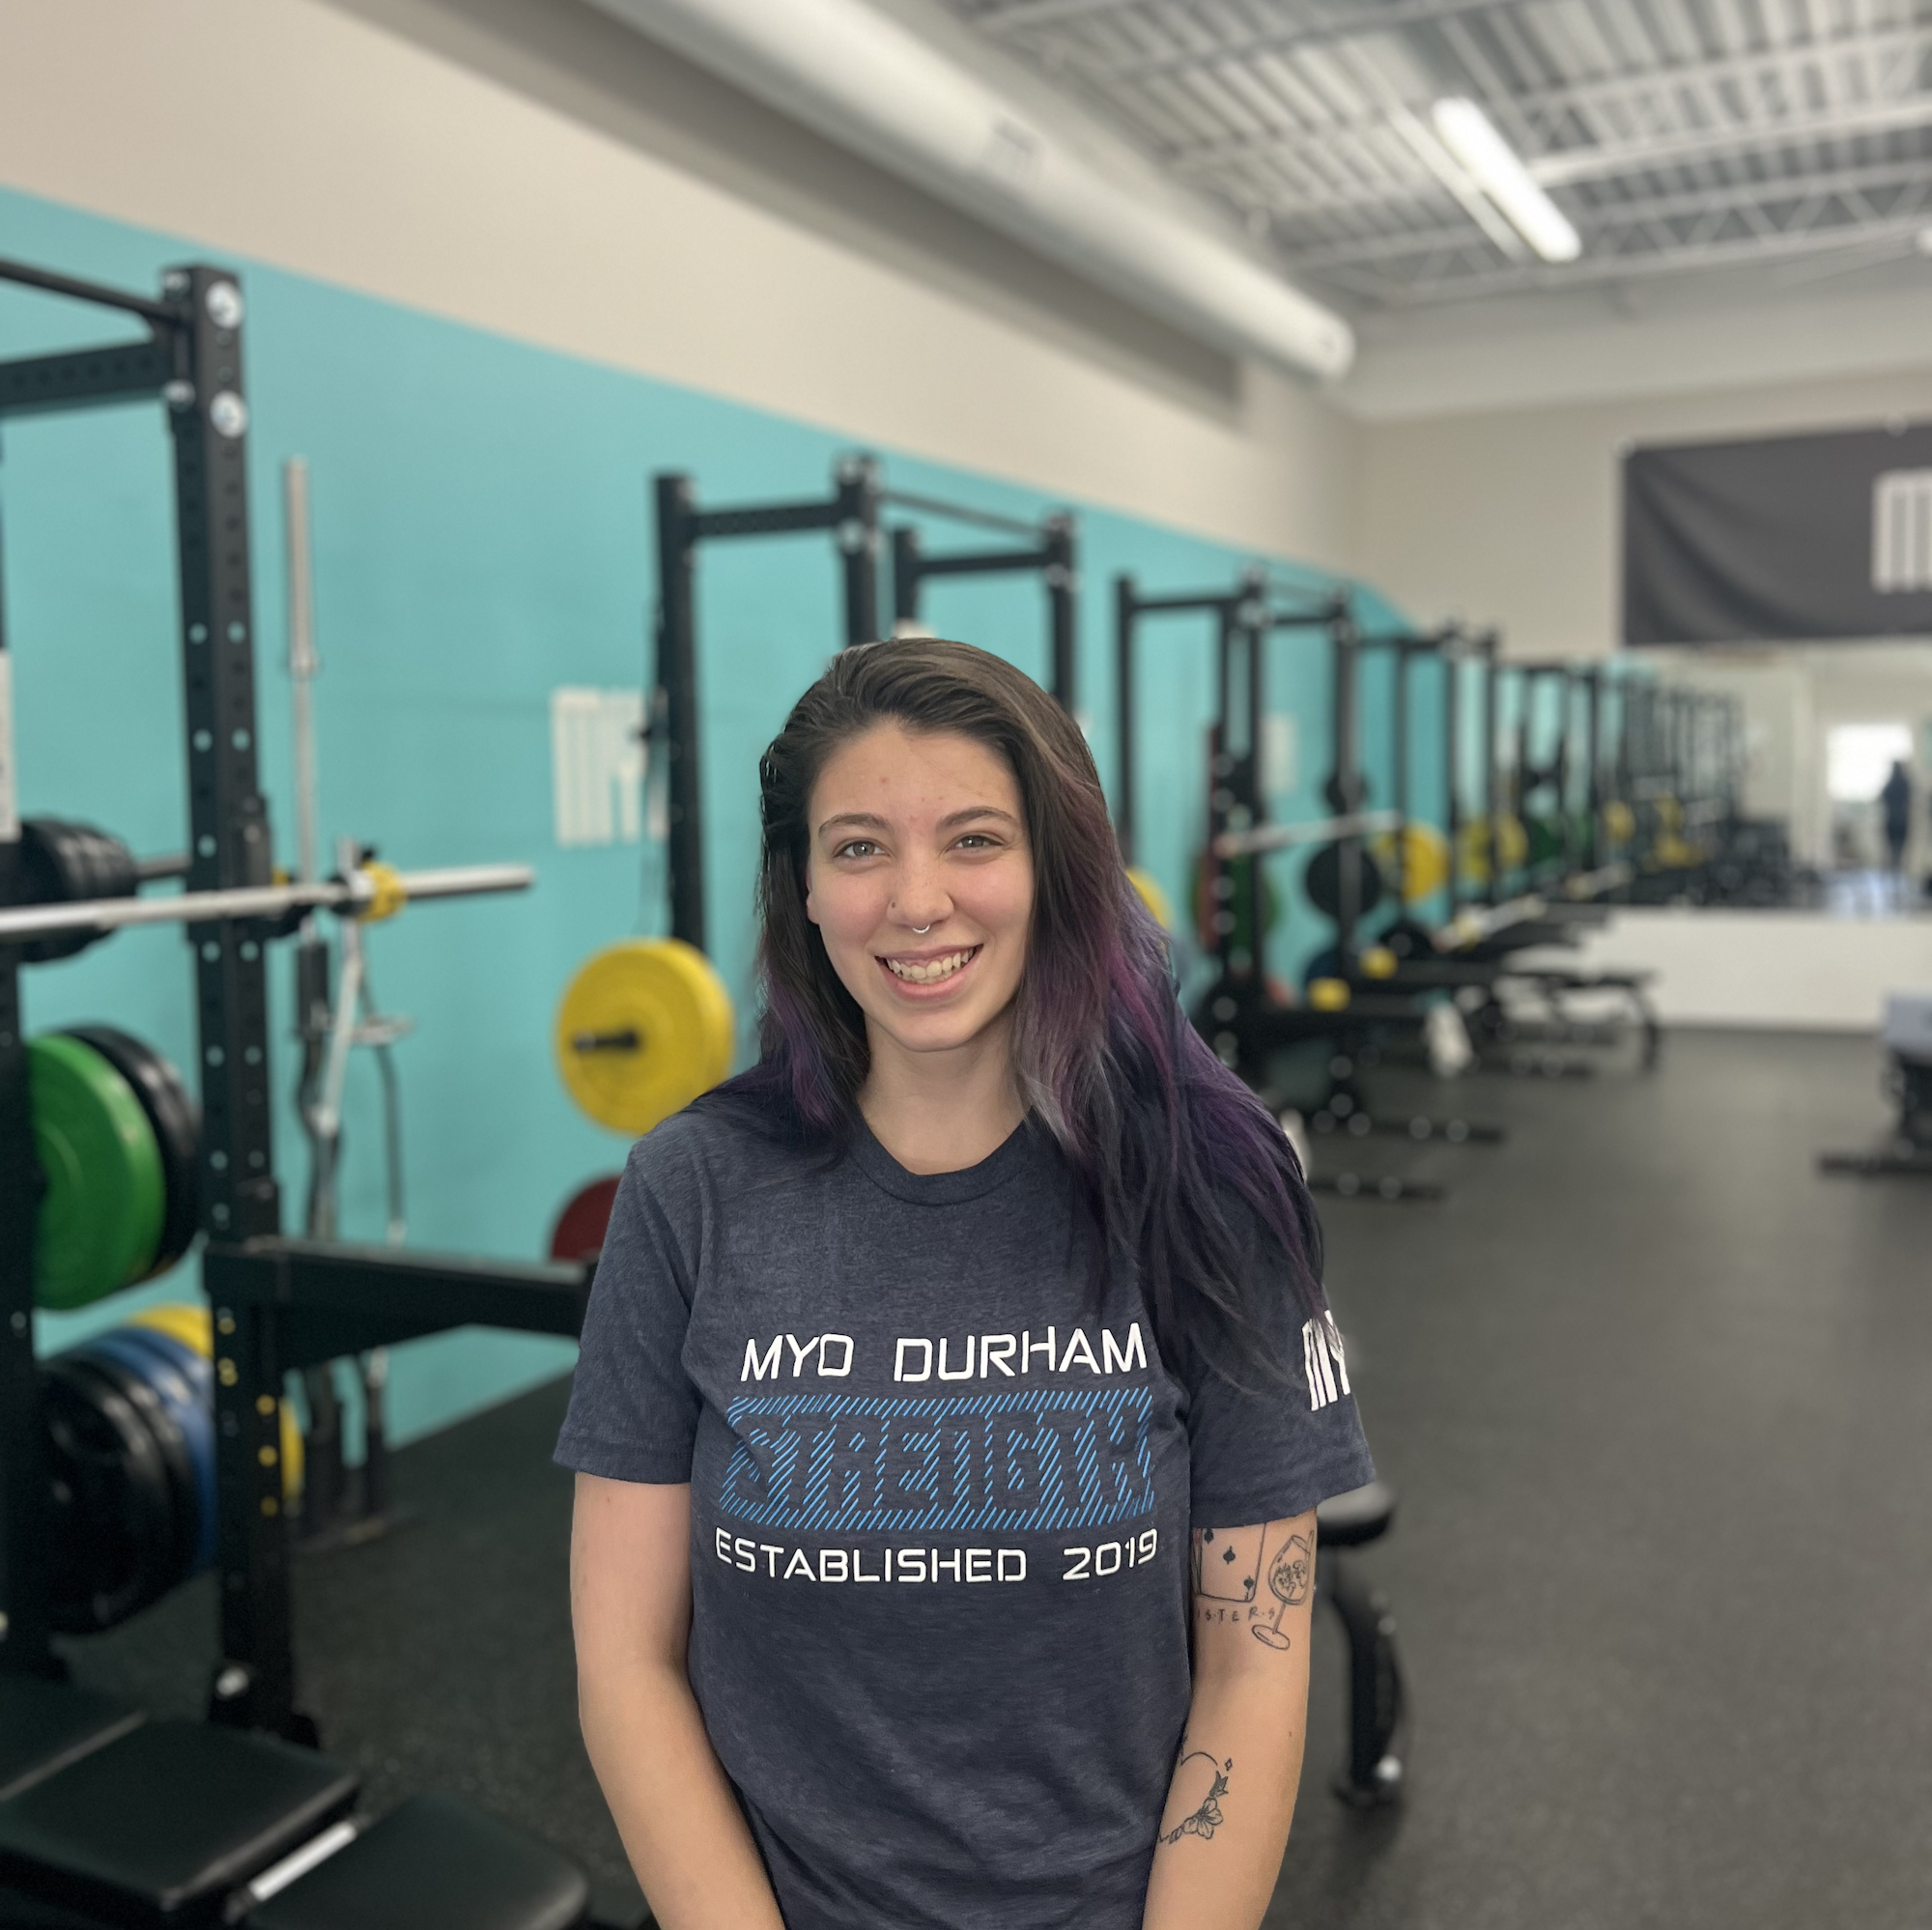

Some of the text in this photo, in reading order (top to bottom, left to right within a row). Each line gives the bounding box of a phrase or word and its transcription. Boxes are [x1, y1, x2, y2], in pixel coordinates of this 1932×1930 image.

[740, 1321, 1148, 1382] MYO DURHAM
[724, 1395, 1152, 1524] STRENGTH
[715, 1527, 1159, 1582] ESTABLISHED 2019
